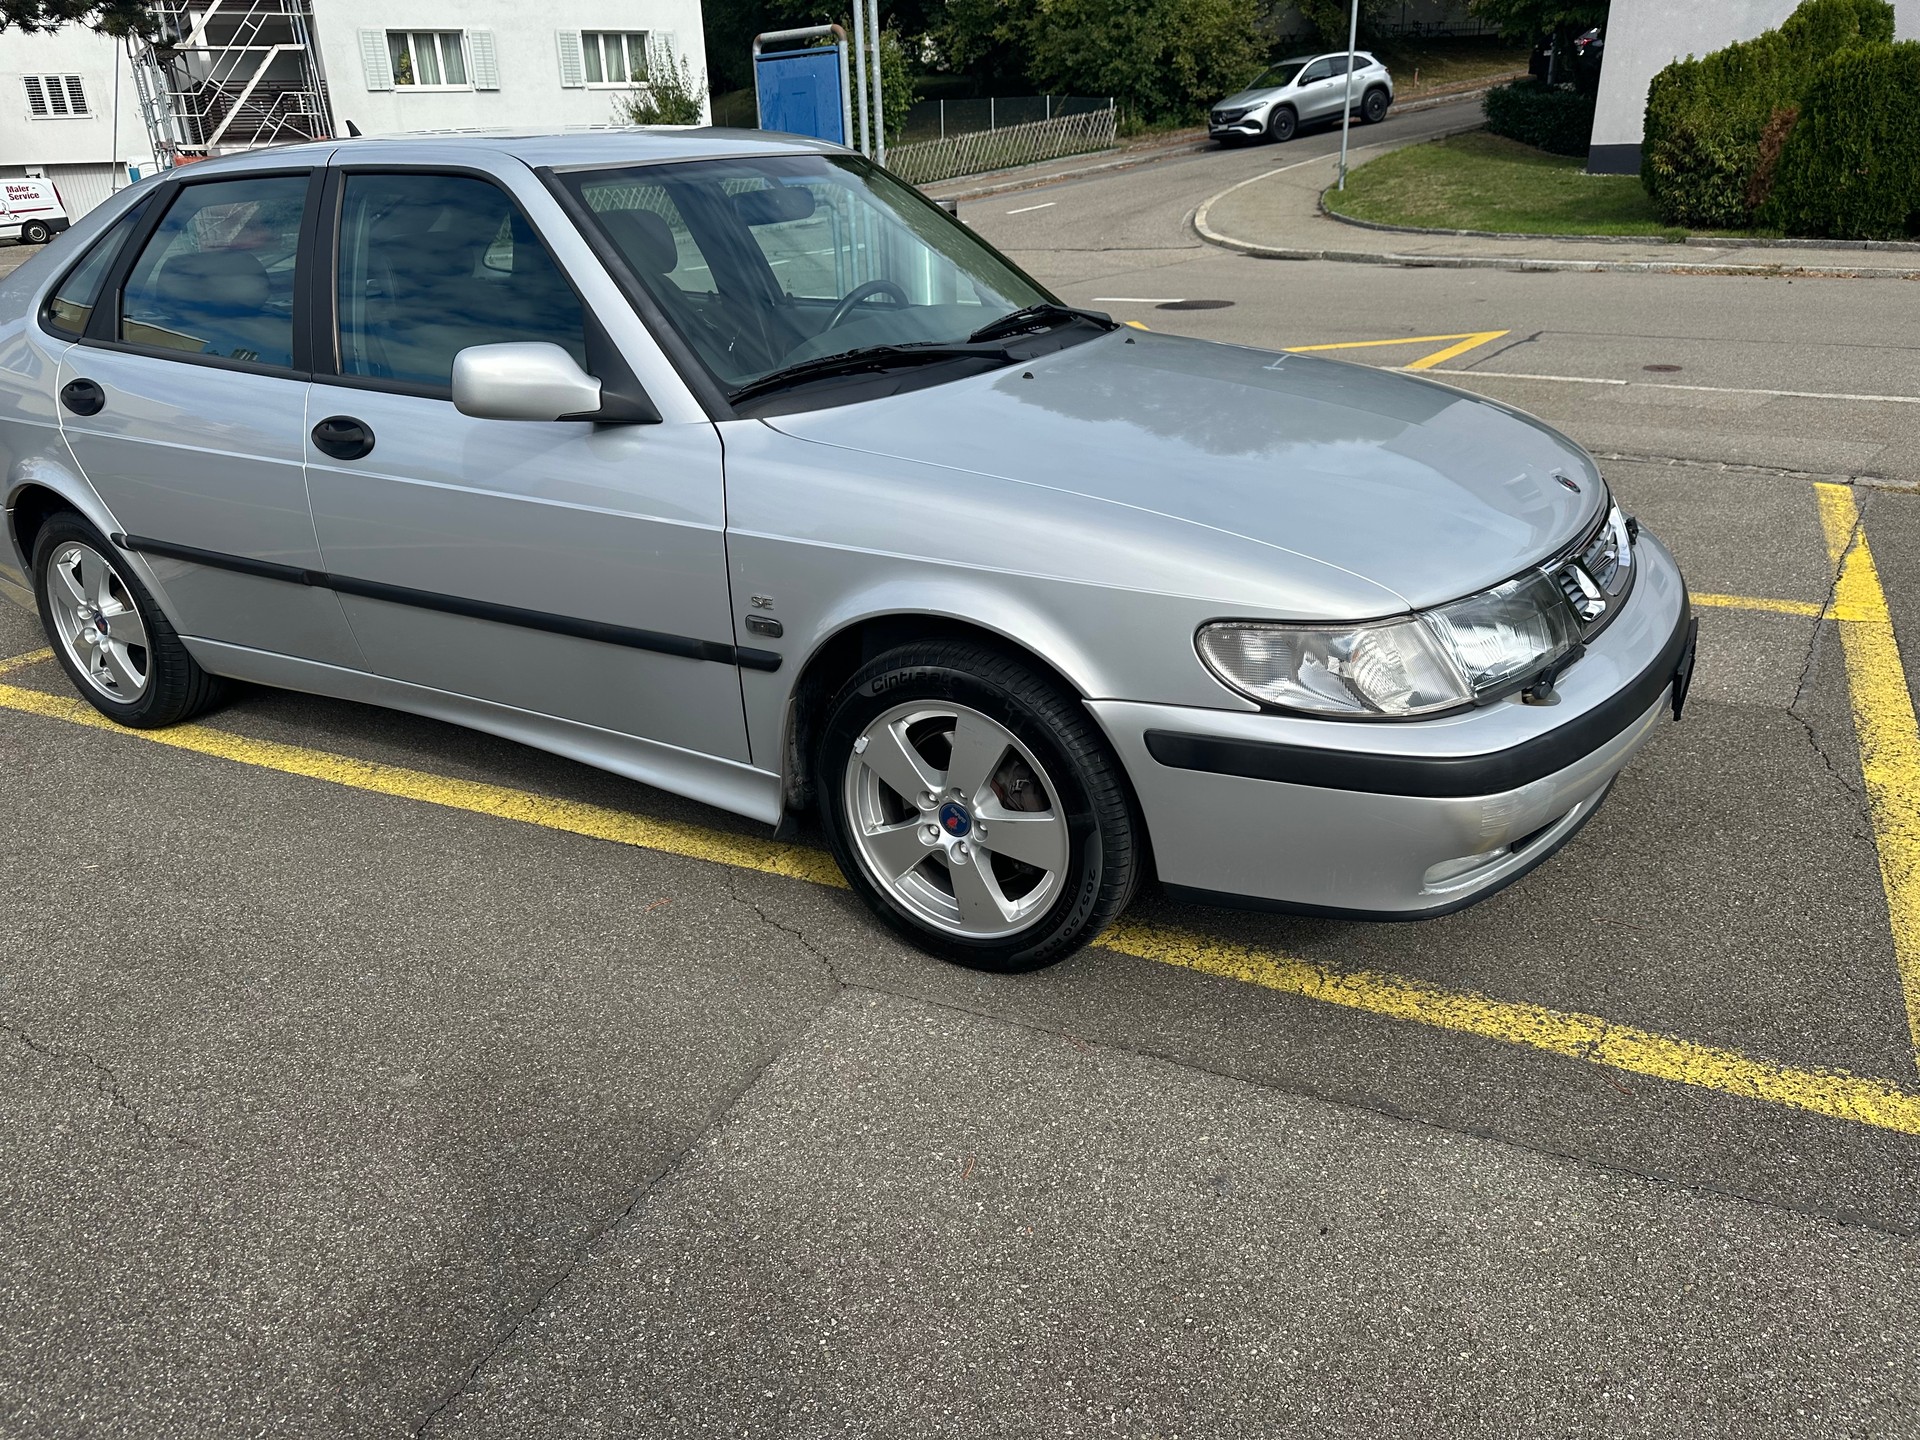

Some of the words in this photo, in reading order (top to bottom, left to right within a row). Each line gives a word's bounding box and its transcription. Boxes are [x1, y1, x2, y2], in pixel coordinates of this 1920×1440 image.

[6, 185, 29, 193] Maler
[9, 192, 39, 200] Service
[751, 594, 774, 610] SE
[1064, 869, 1096, 936] 205/50
